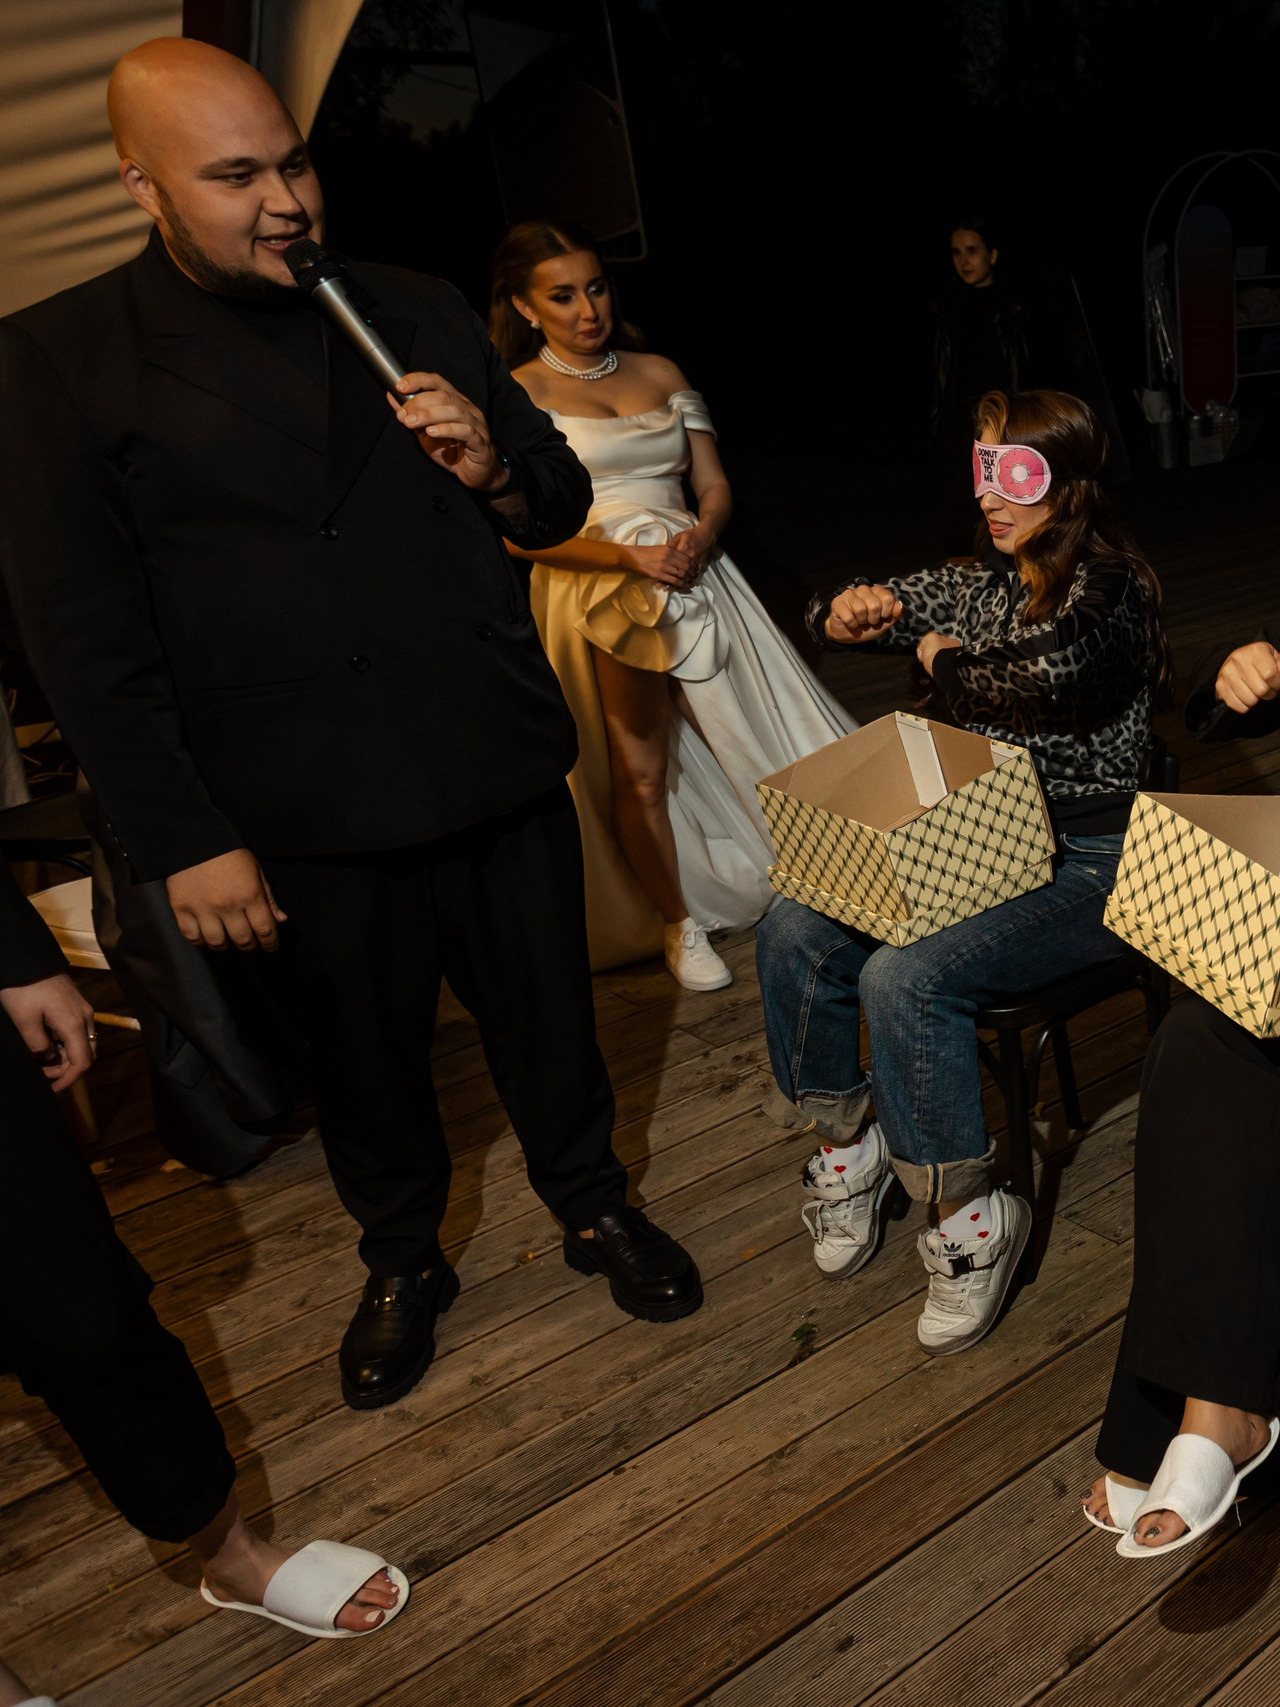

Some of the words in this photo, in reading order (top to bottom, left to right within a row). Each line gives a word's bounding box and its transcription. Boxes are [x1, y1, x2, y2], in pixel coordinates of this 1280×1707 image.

[978, 448, 998, 458] DONUT
[981, 457, 995, 467] TALK
[984, 466, 992, 474] TO
[984, 473, 993, 483] ME
